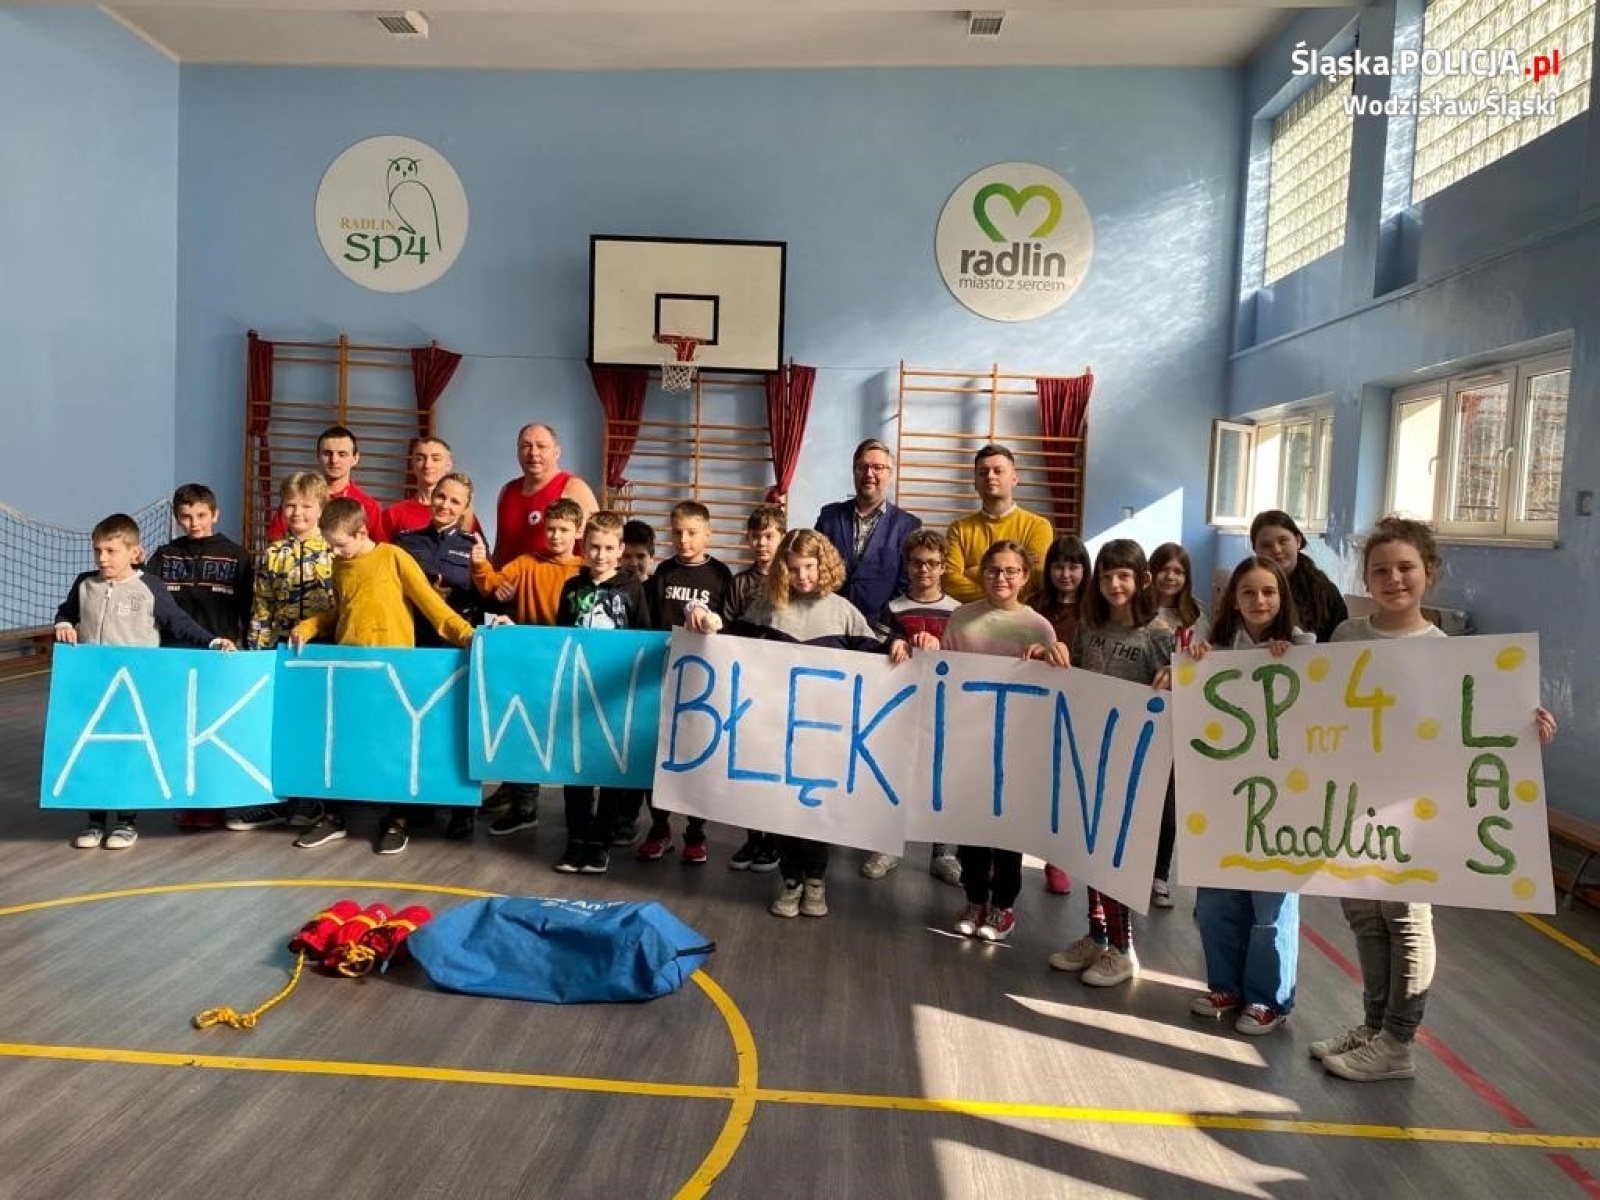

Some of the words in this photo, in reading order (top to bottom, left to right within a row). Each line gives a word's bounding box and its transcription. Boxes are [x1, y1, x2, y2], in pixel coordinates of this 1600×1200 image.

[340, 217, 396, 231] RADLIN
[960, 241, 1066, 277] radlin
[959, 277, 1004, 290] miasto
[1006, 280, 1015, 290] z
[1017, 280, 1065, 292] sercem
[665, 585, 711, 603] SKILLS
[1112, 641, 1140, 661] THE
[52, 634, 673, 800] AKTYWN
[1190, 663, 1301, 761] SP
[1305, 723, 1350, 754] nr
[1344, 648, 1397, 753] 4
[1232, 776, 1412, 864] Radlin
